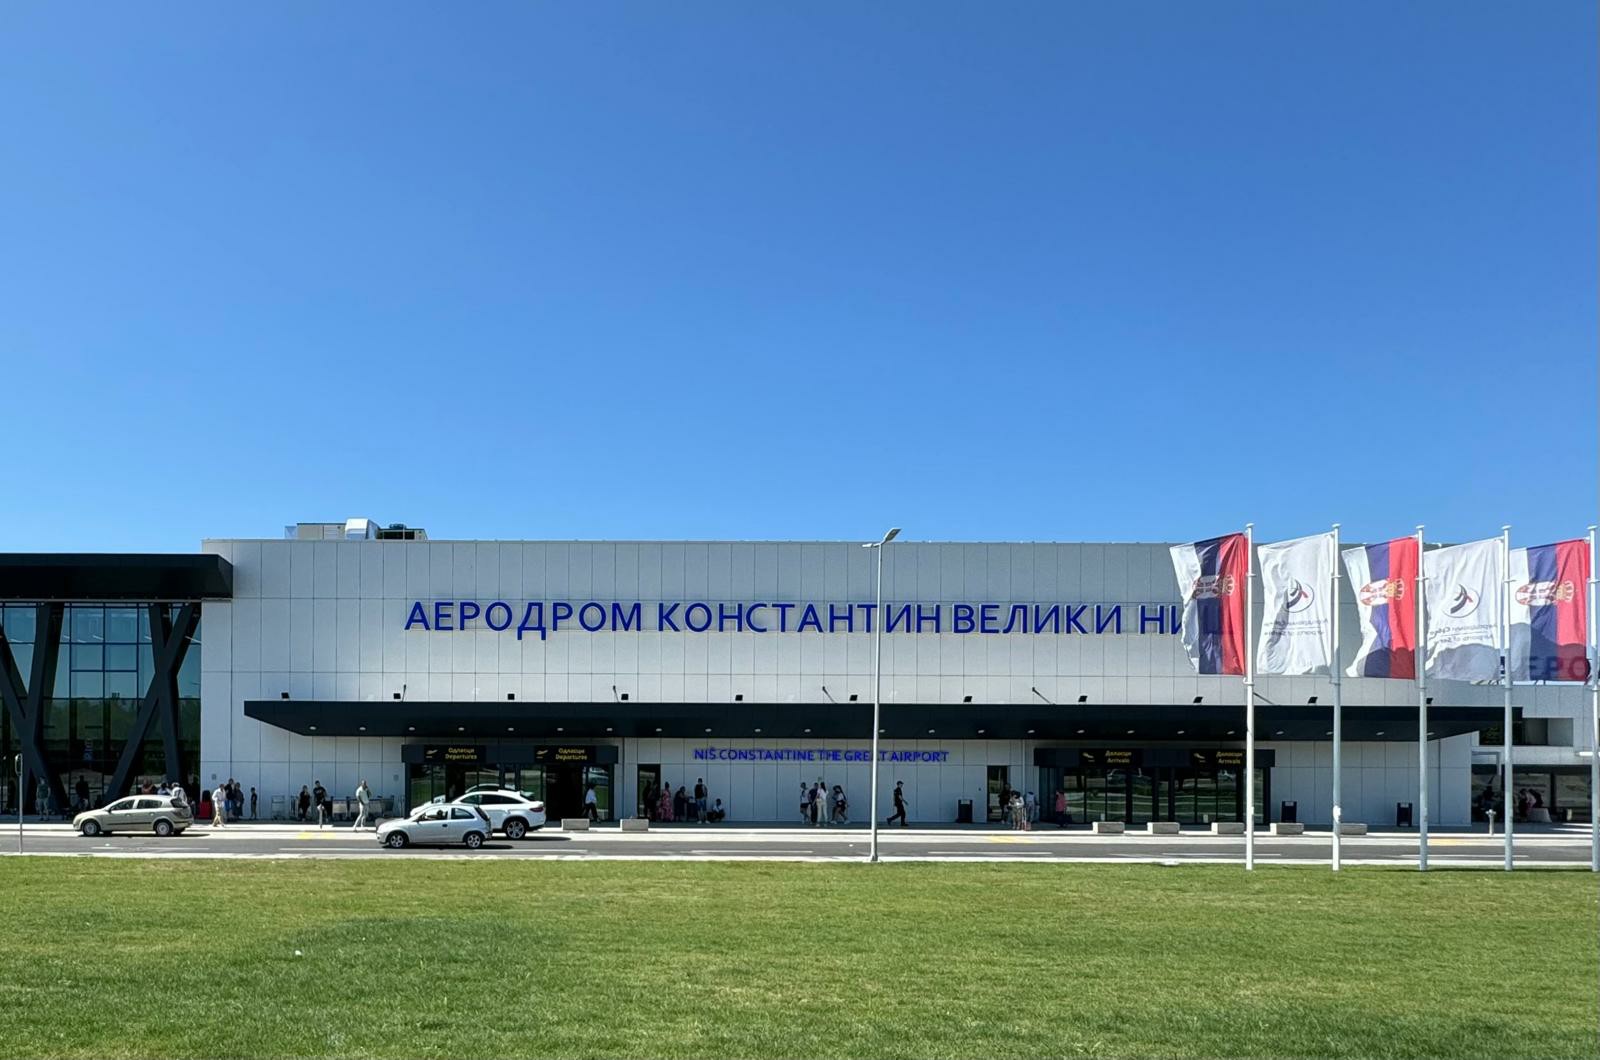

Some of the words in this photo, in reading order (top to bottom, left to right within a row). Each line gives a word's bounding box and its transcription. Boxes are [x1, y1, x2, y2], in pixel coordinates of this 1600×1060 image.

[404, 601, 642, 640] АЕРОДРОМ
[657, 602, 942, 634] КОНСТАНТИН
[952, 604, 1121, 635] ВЕЛИКИ
[445, 753, 478, 761] Departures
[694, 747, 716, 761] NIŠ
[719, 749, 815, 761] CONSTANTINE
[817, 750, 841, 761] THE
[891, 750, 950, 762] AIRPORT
